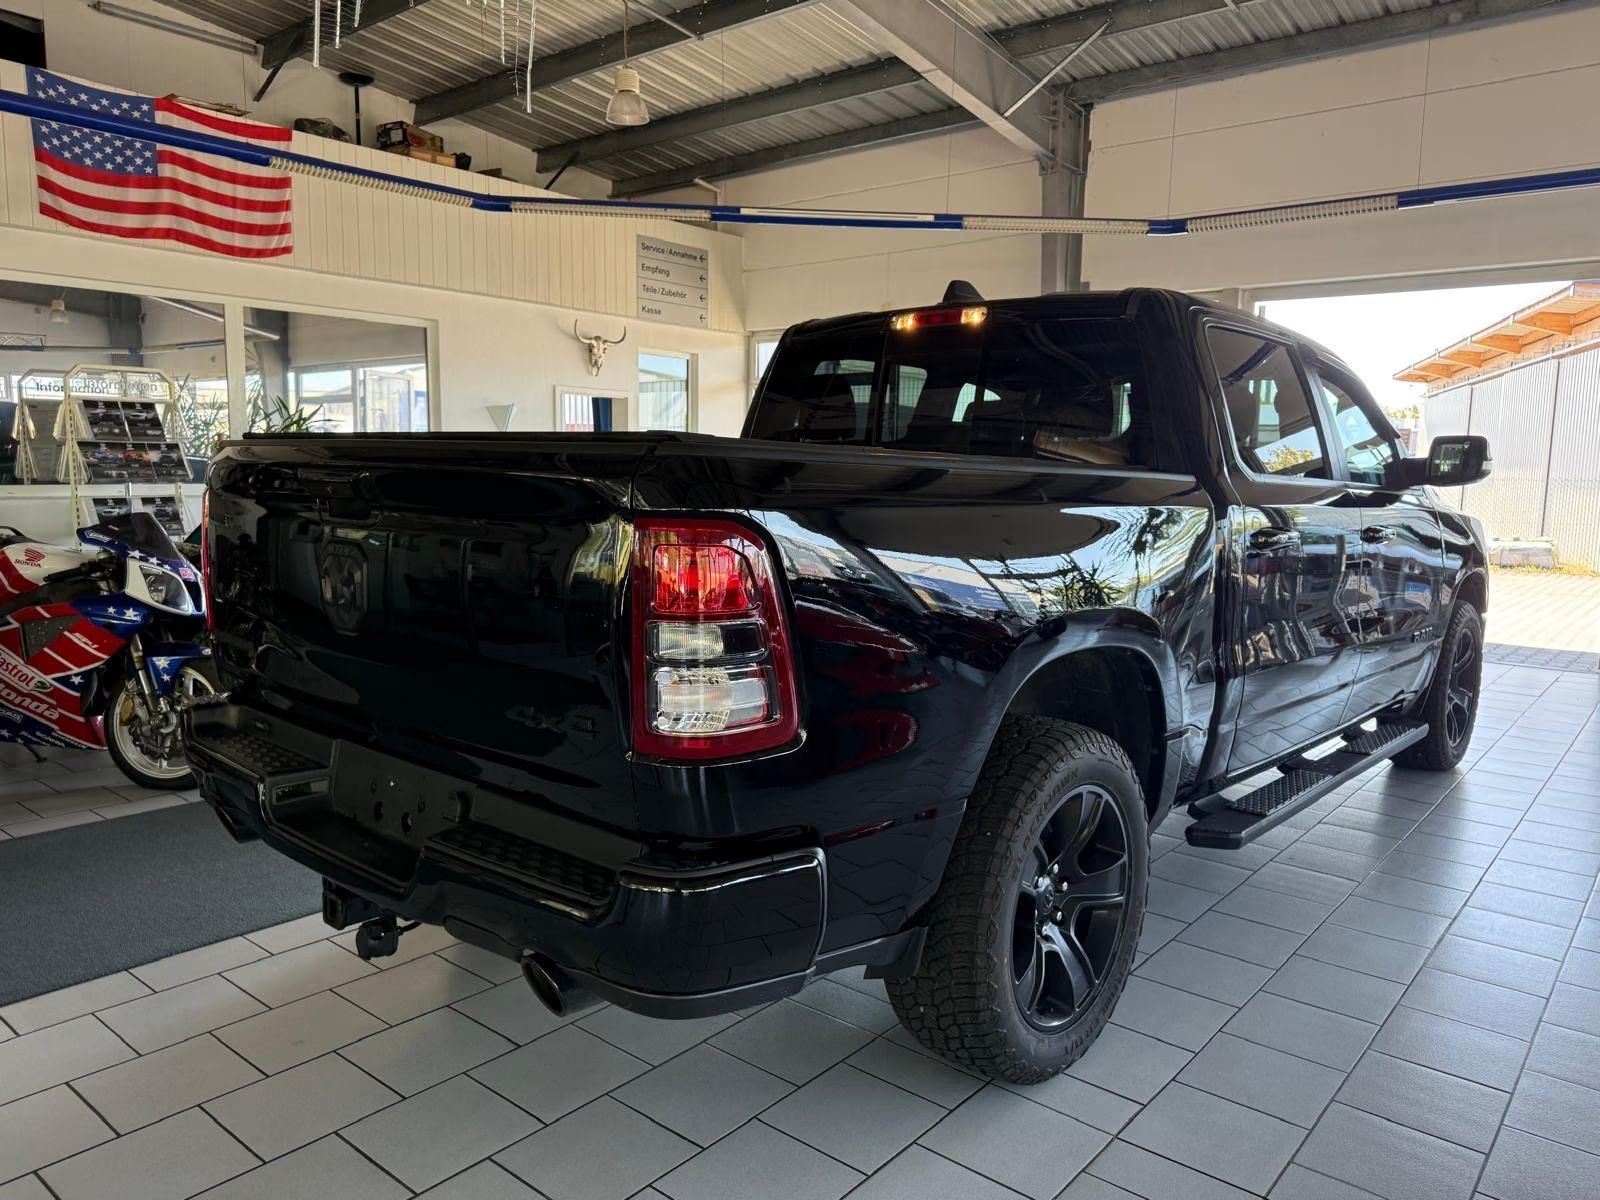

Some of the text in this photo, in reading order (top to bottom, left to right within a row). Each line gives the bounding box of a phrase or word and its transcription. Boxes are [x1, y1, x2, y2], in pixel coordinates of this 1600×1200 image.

[641, 263, 670, 278] Empfang
[641, 304, 662, 315] Kasse
[14, 558, 42, 568] HONDA
[1413, 626, 1433, 643] RAM
[0, 656, 36, 687] astrol
